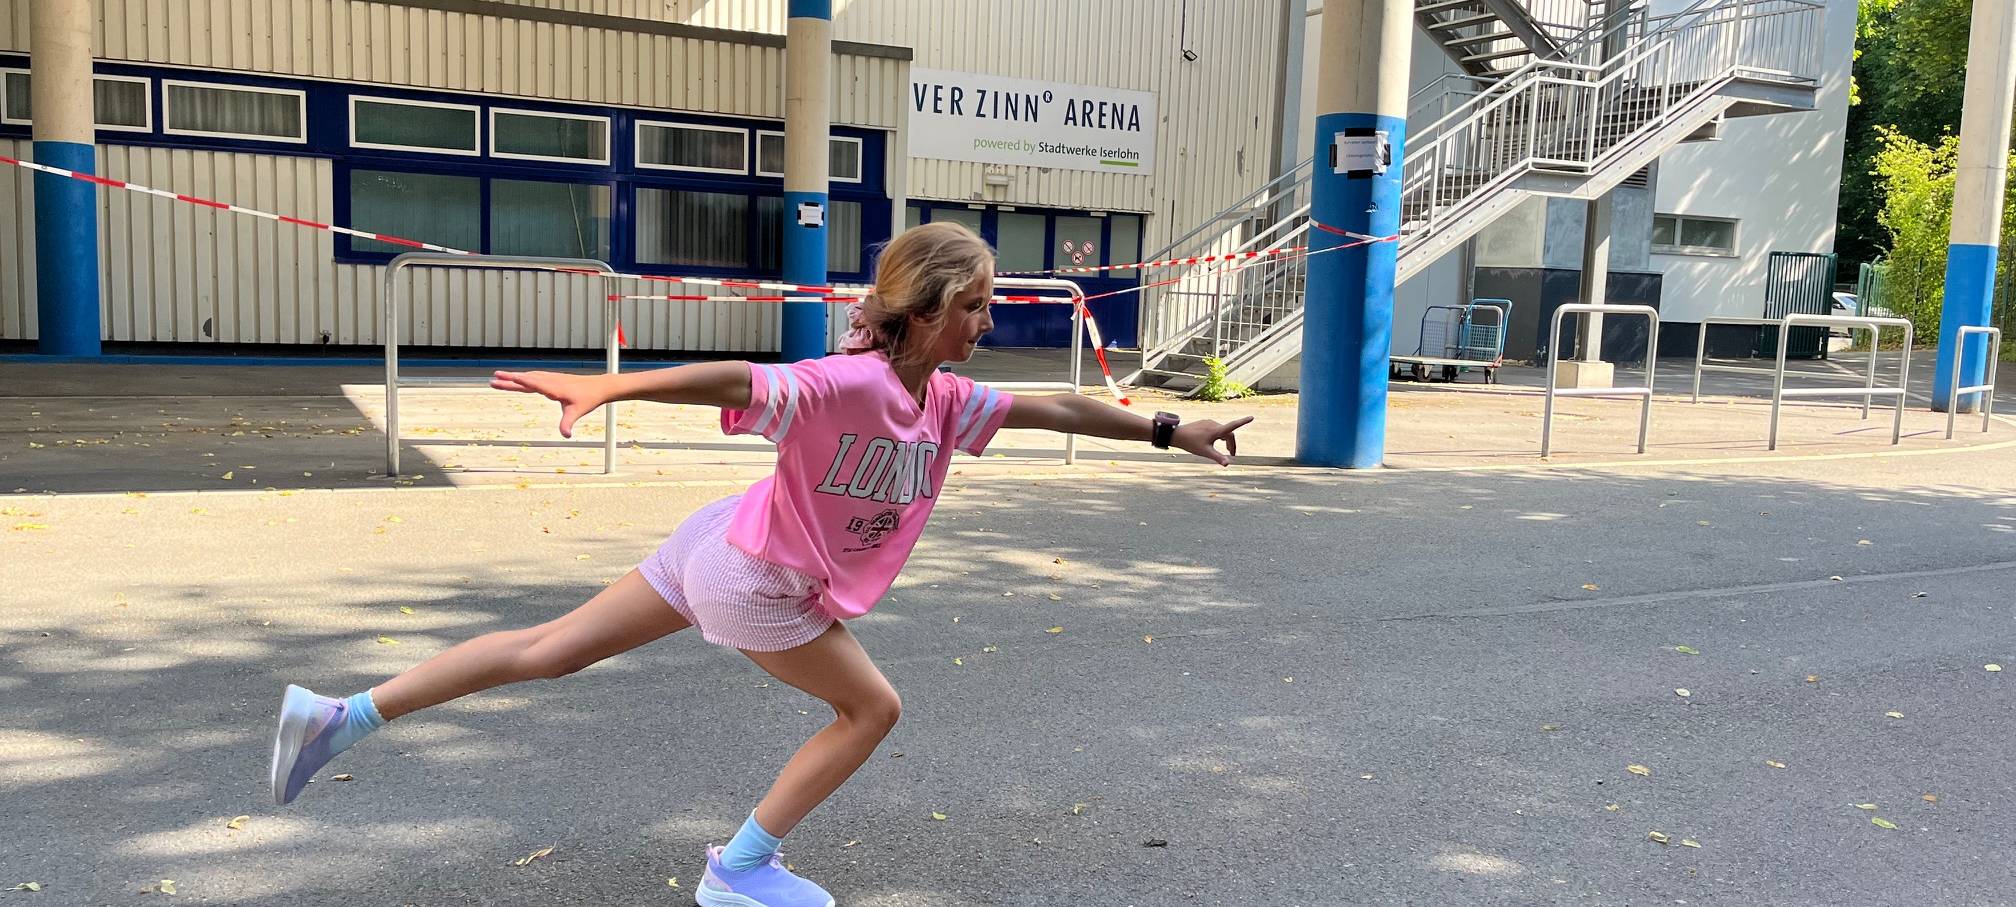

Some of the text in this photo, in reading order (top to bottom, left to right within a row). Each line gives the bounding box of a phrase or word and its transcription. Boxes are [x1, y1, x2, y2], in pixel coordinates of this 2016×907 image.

[1063, 98, 1141, 132] ARENA
[973, 137, 1139, 160] powered by Stadtwerke Iserlohn
